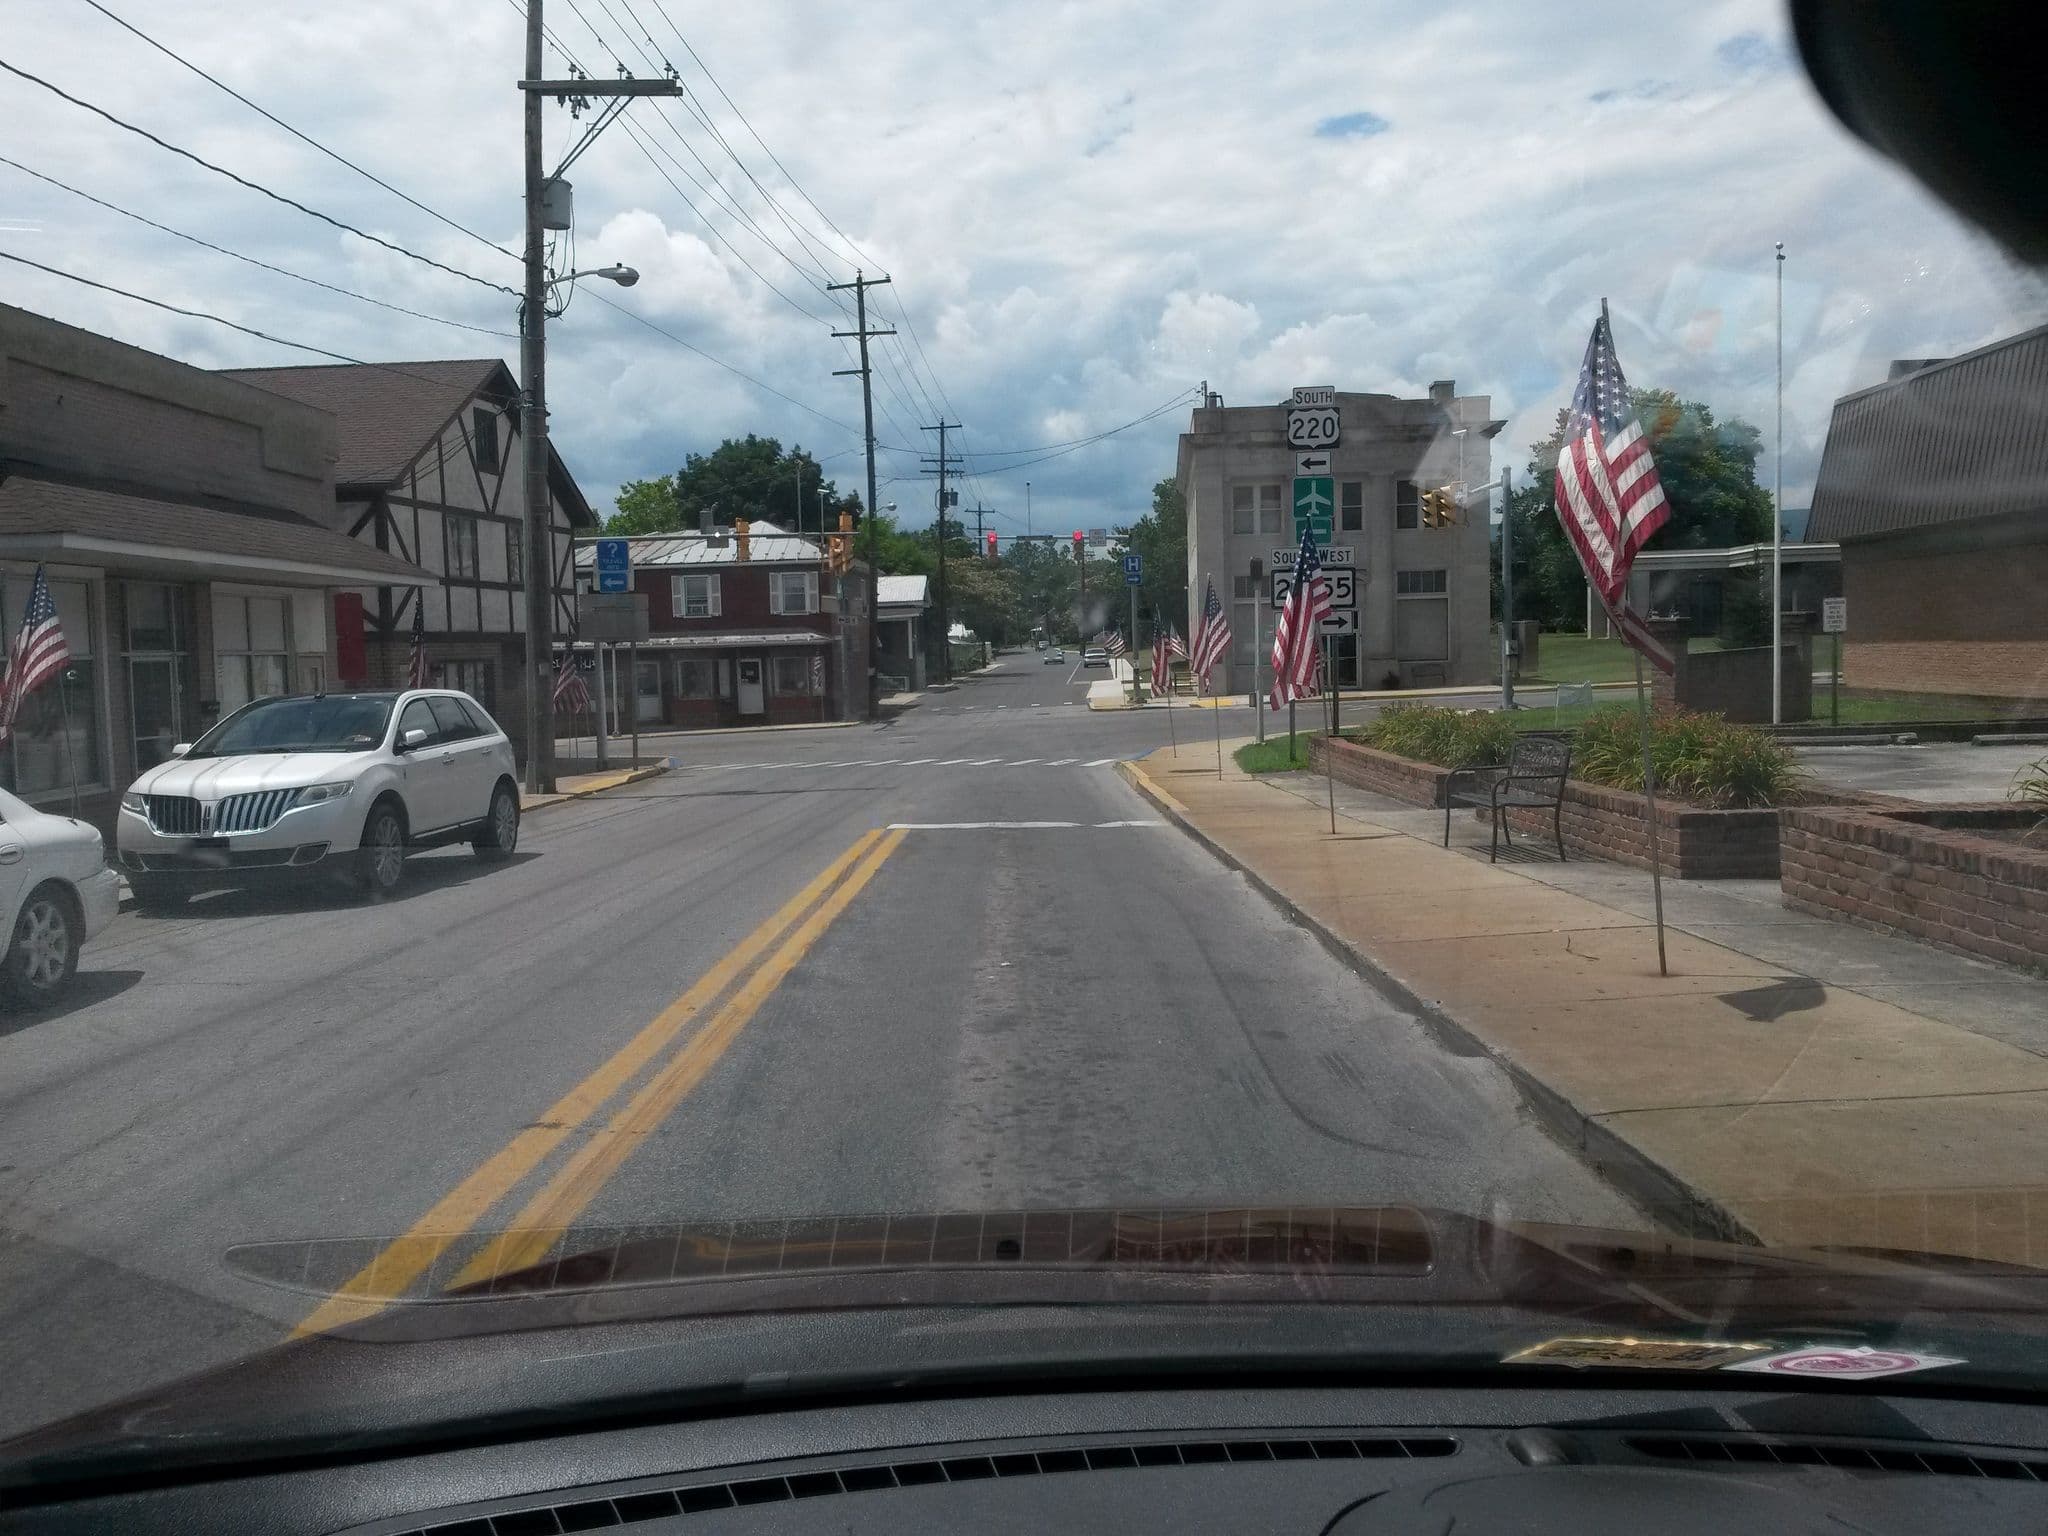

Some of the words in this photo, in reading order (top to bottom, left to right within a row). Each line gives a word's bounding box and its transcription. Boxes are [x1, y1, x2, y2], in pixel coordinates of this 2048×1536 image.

[1295, 391, 1332, 404] SOUTH
[1292, 416, 1335, 439] 220
[1273, 551, 1298, 564] SOU
[1319, 549, 1351, 562] WEST
